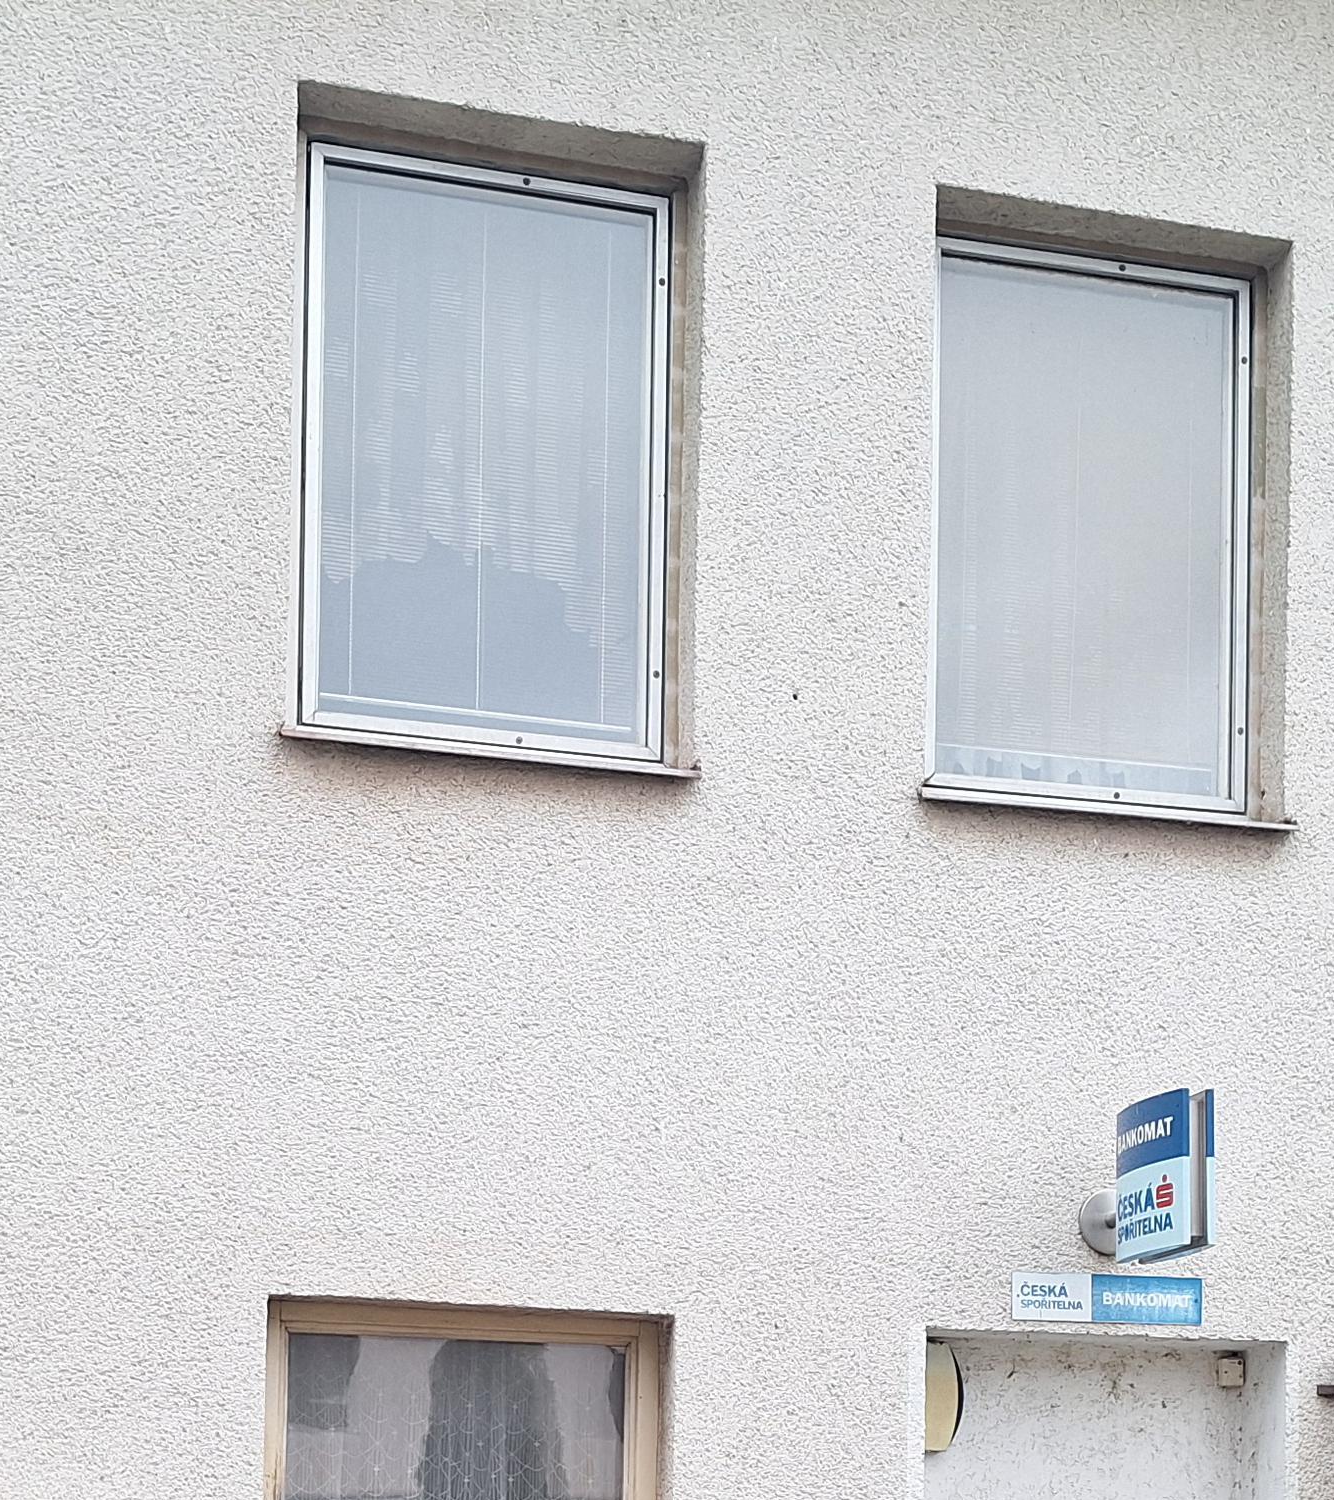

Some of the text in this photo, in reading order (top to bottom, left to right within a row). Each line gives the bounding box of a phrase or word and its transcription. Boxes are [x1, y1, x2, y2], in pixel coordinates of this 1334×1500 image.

[1117, 1115, 1174, 1155] BANKOMAT
[1117, 1182, 1155, 1222] ČESKÁ
[1117, 1212, 1174, 1245] SPOŘITELNA
[1020, 1281, 1191, 1308] ČESKÁ BANKOMAT
[1020, 1298, 1083, 1310] SPOŘITELNA
